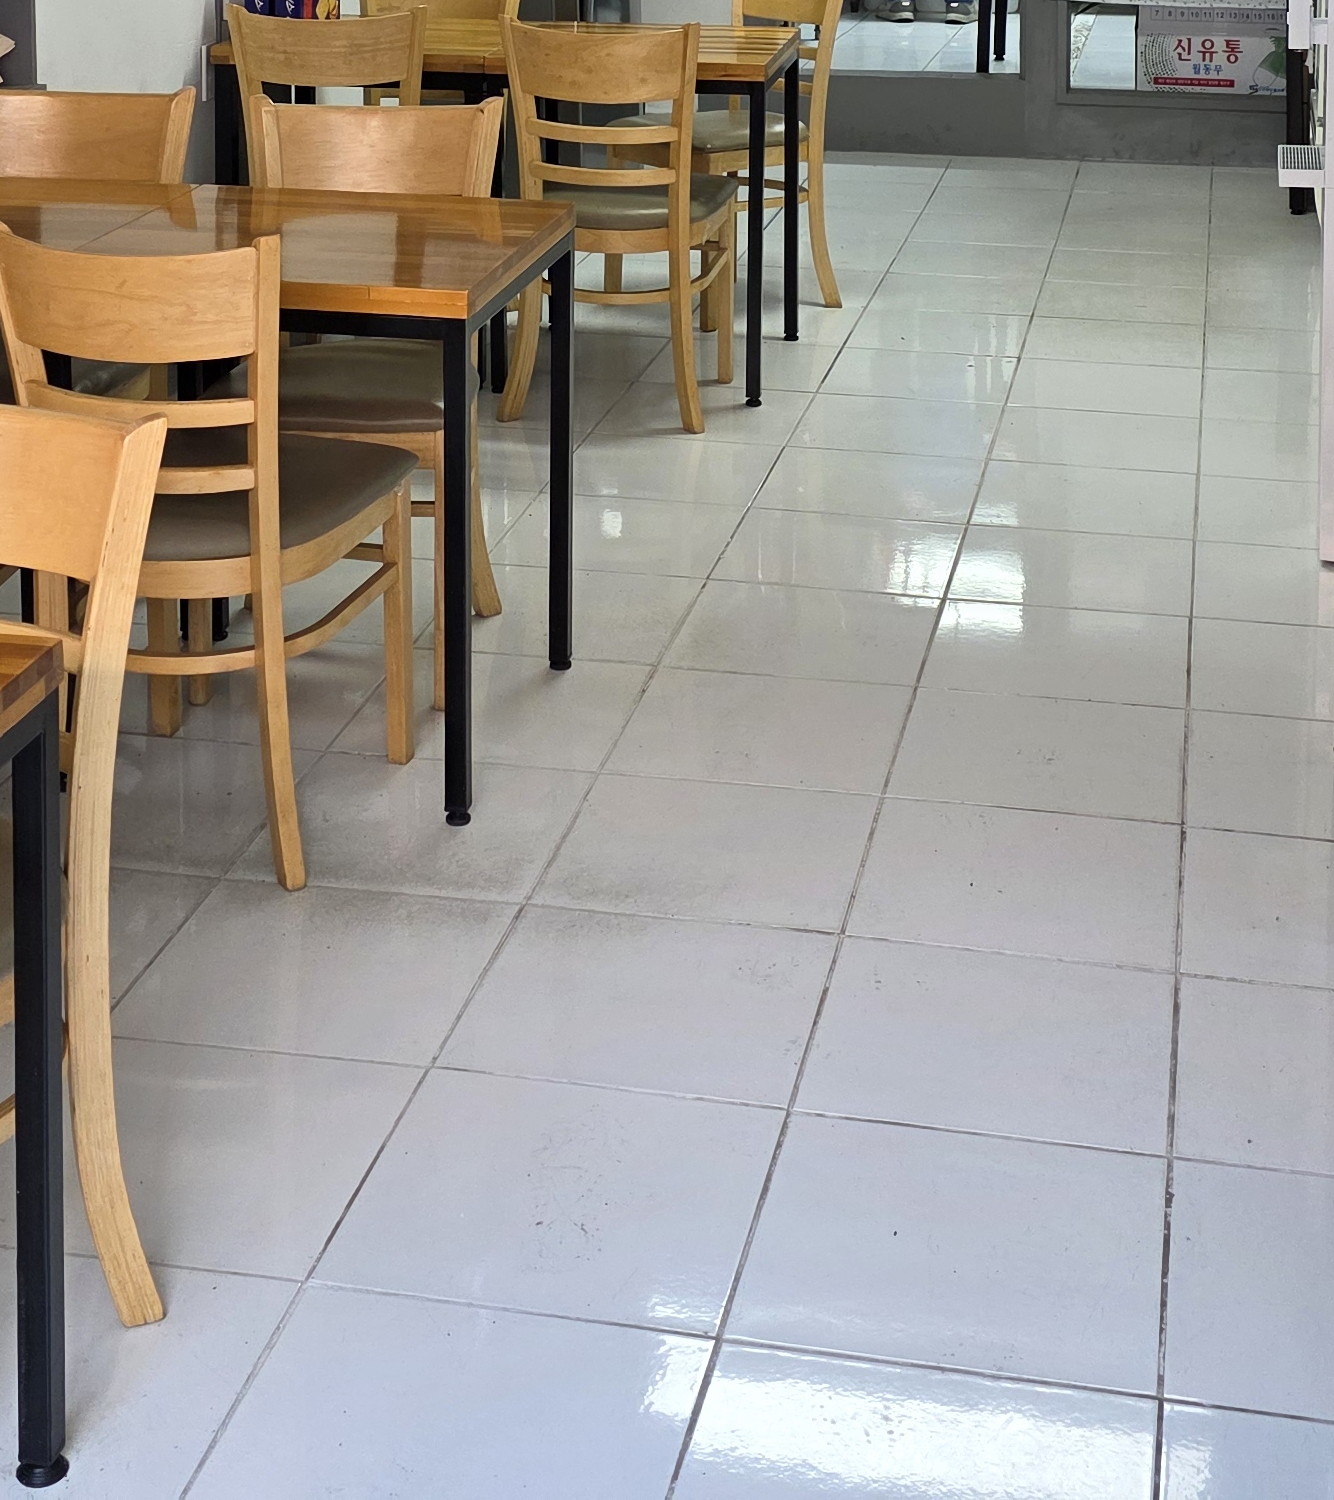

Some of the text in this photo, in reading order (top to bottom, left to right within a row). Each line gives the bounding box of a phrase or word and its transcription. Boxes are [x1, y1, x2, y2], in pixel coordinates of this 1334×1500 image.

[1216, 11, 1224, 19] 12
[1254, 12, 1262, 20] 15
[1173, 37, 1244, 64] 신유통
